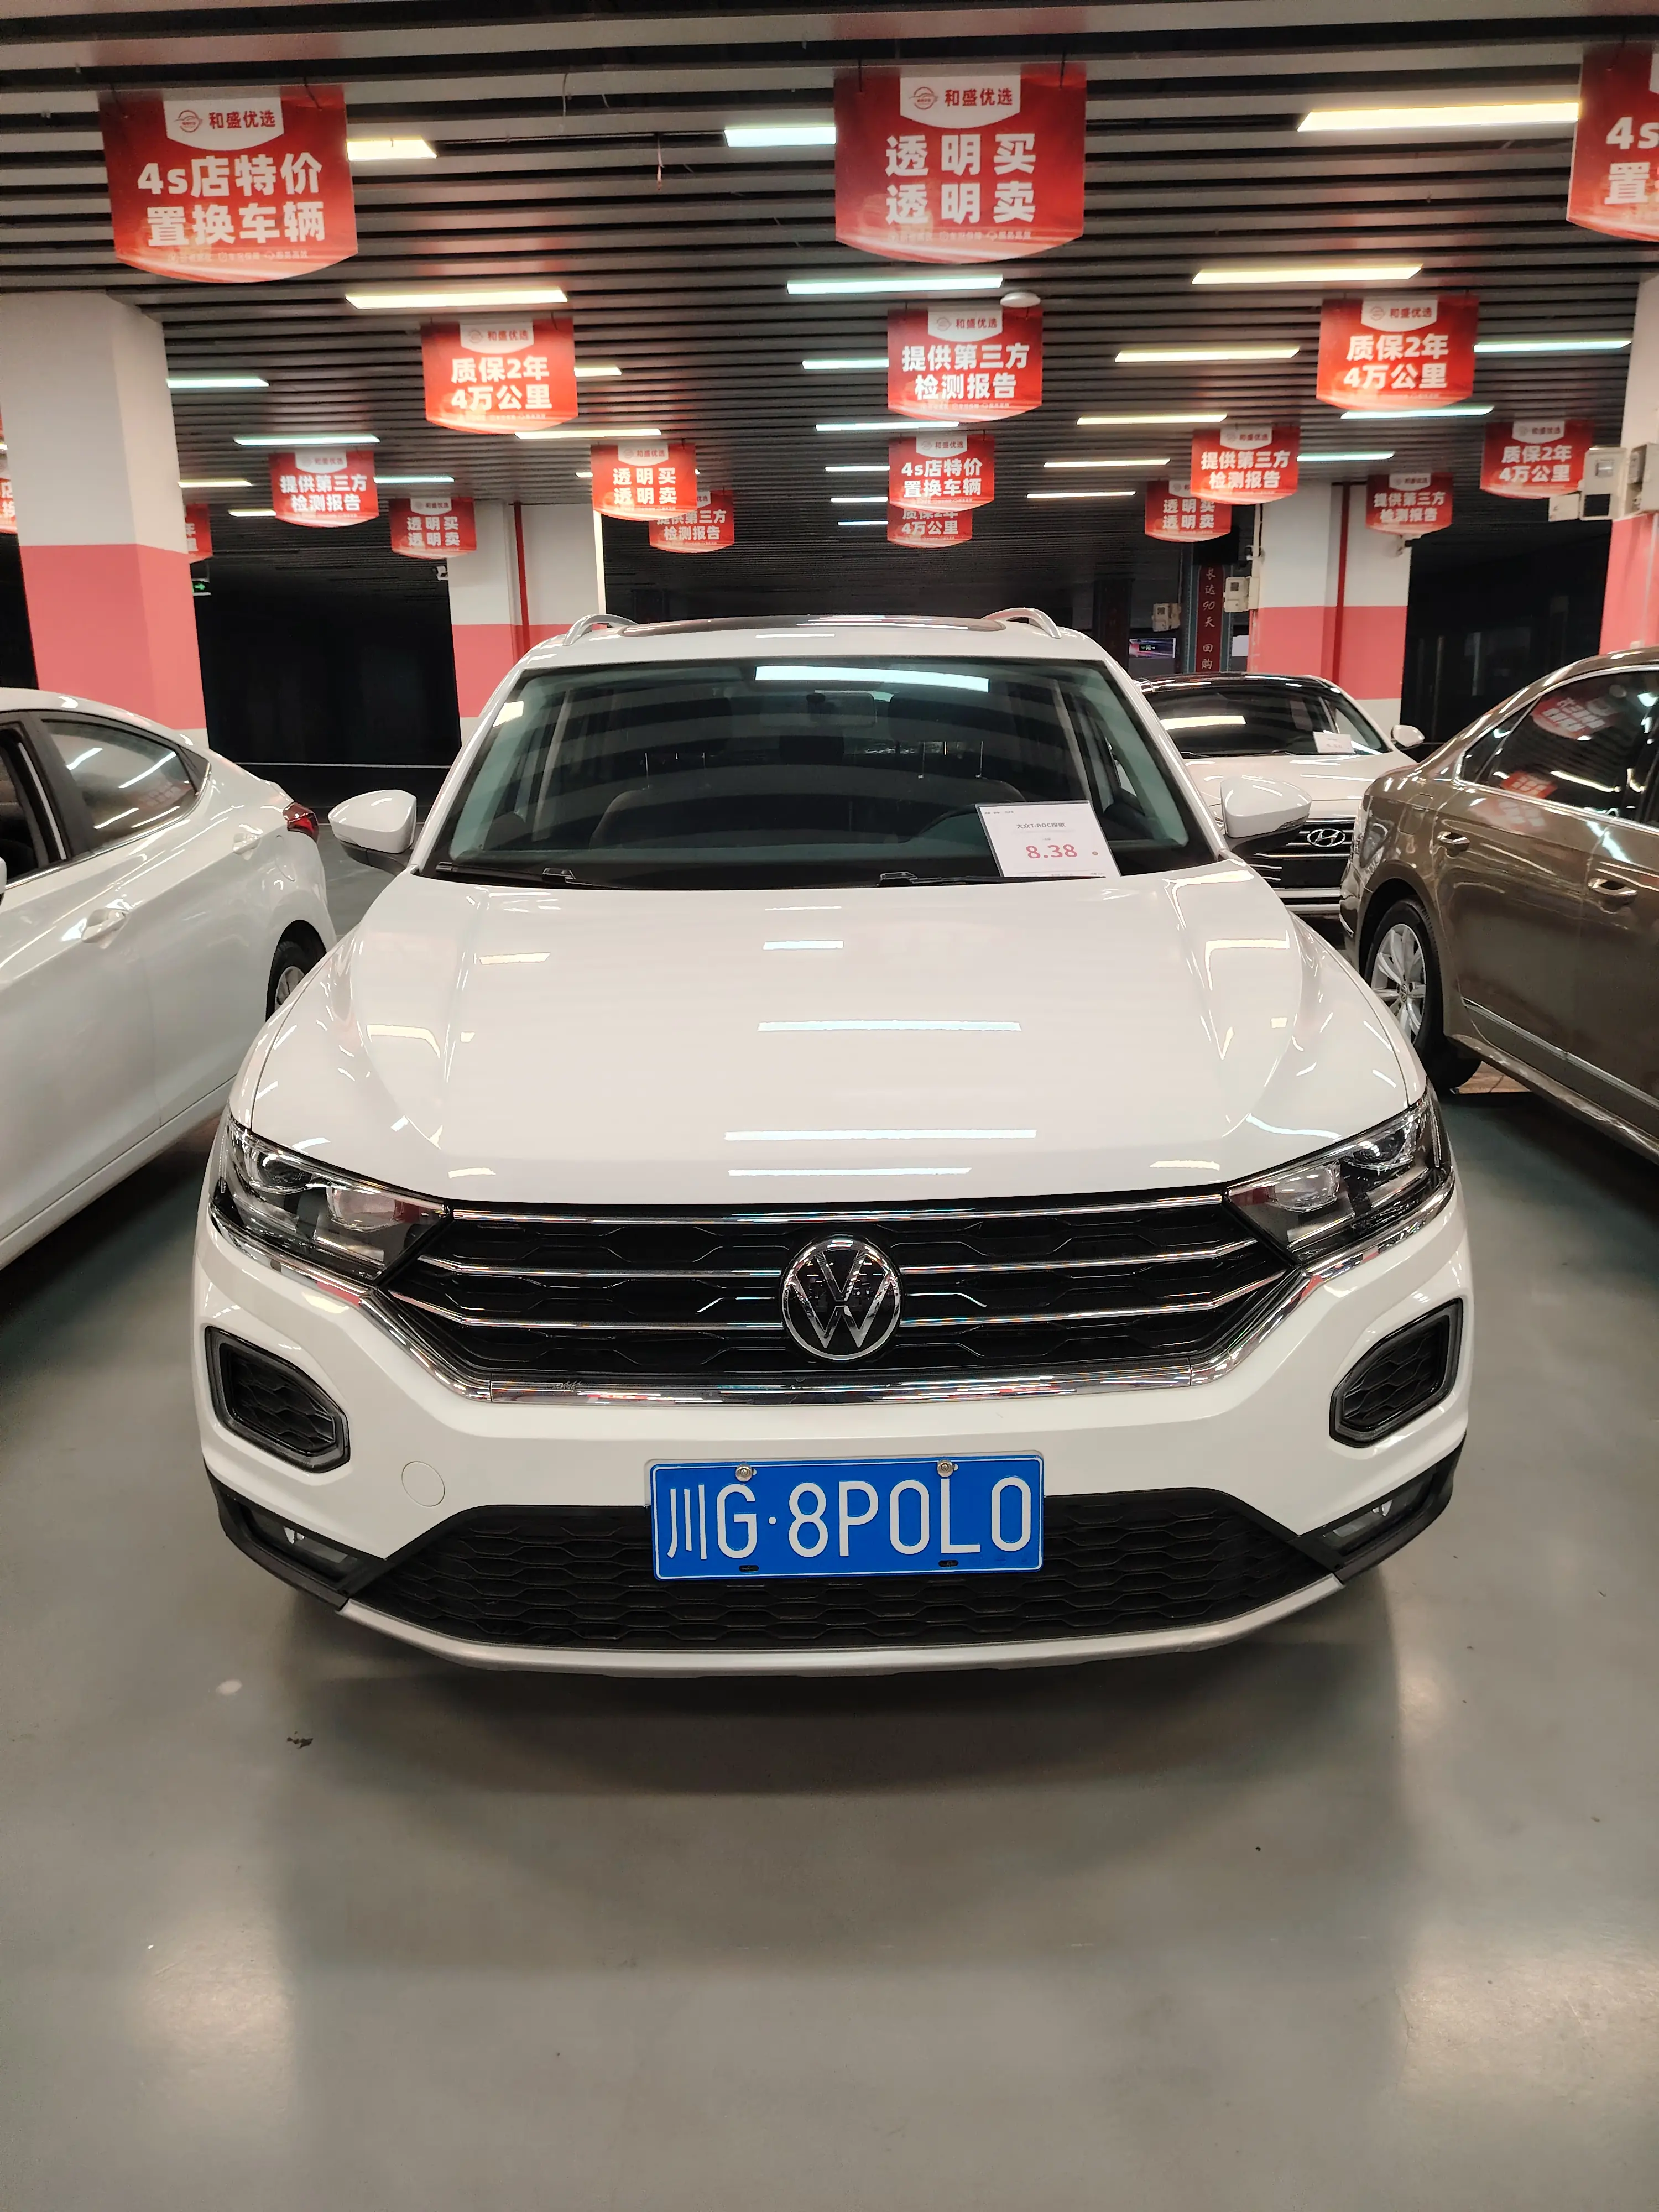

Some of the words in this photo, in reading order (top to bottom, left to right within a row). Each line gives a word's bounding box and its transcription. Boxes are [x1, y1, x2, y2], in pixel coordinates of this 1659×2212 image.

[945, 88, 1013, 106] 和盛优选
[210, 111, 276, 129] 和盛优选
[885, 133, 1036, 176] 透明买
[138, 152, 322, 198] 4s店特价
[1604, 161, 1659, 205] 置
[885, 181, 1036, 225] 透明卖
[147, 201, 325, 247] 置换车辆
[902, 342, 1030, 372] 提供第三方
[1346, 333, 1449, 361] 质保2年
[451, 356, 550, 384] 质保2年
[1343, 363, 1447, 390] 4万公里
[915, 372, 1016, 400] 检测报告
[451, 384, 552, 411] 4万公里
[1201, 450, 1291, 470] 提供第三方
[1501, 445, 1572, 463] 质保2年
[901, 458, 983, 477] 4s店特价
[1499, 465, 1571, 483] 4万公里
[280, 474, 367, 494] 提供第三方
[904, 478, 982, 498] 置换车辆
[1209, 471, 1280, 489] 检测报告
[291, 494, 361, 512] 检测报告
[664, 525, 721, 541] 检测报告
[901, 520, 959, 535] 4万公里
[1026, 844, 1078, 859] 8.38
